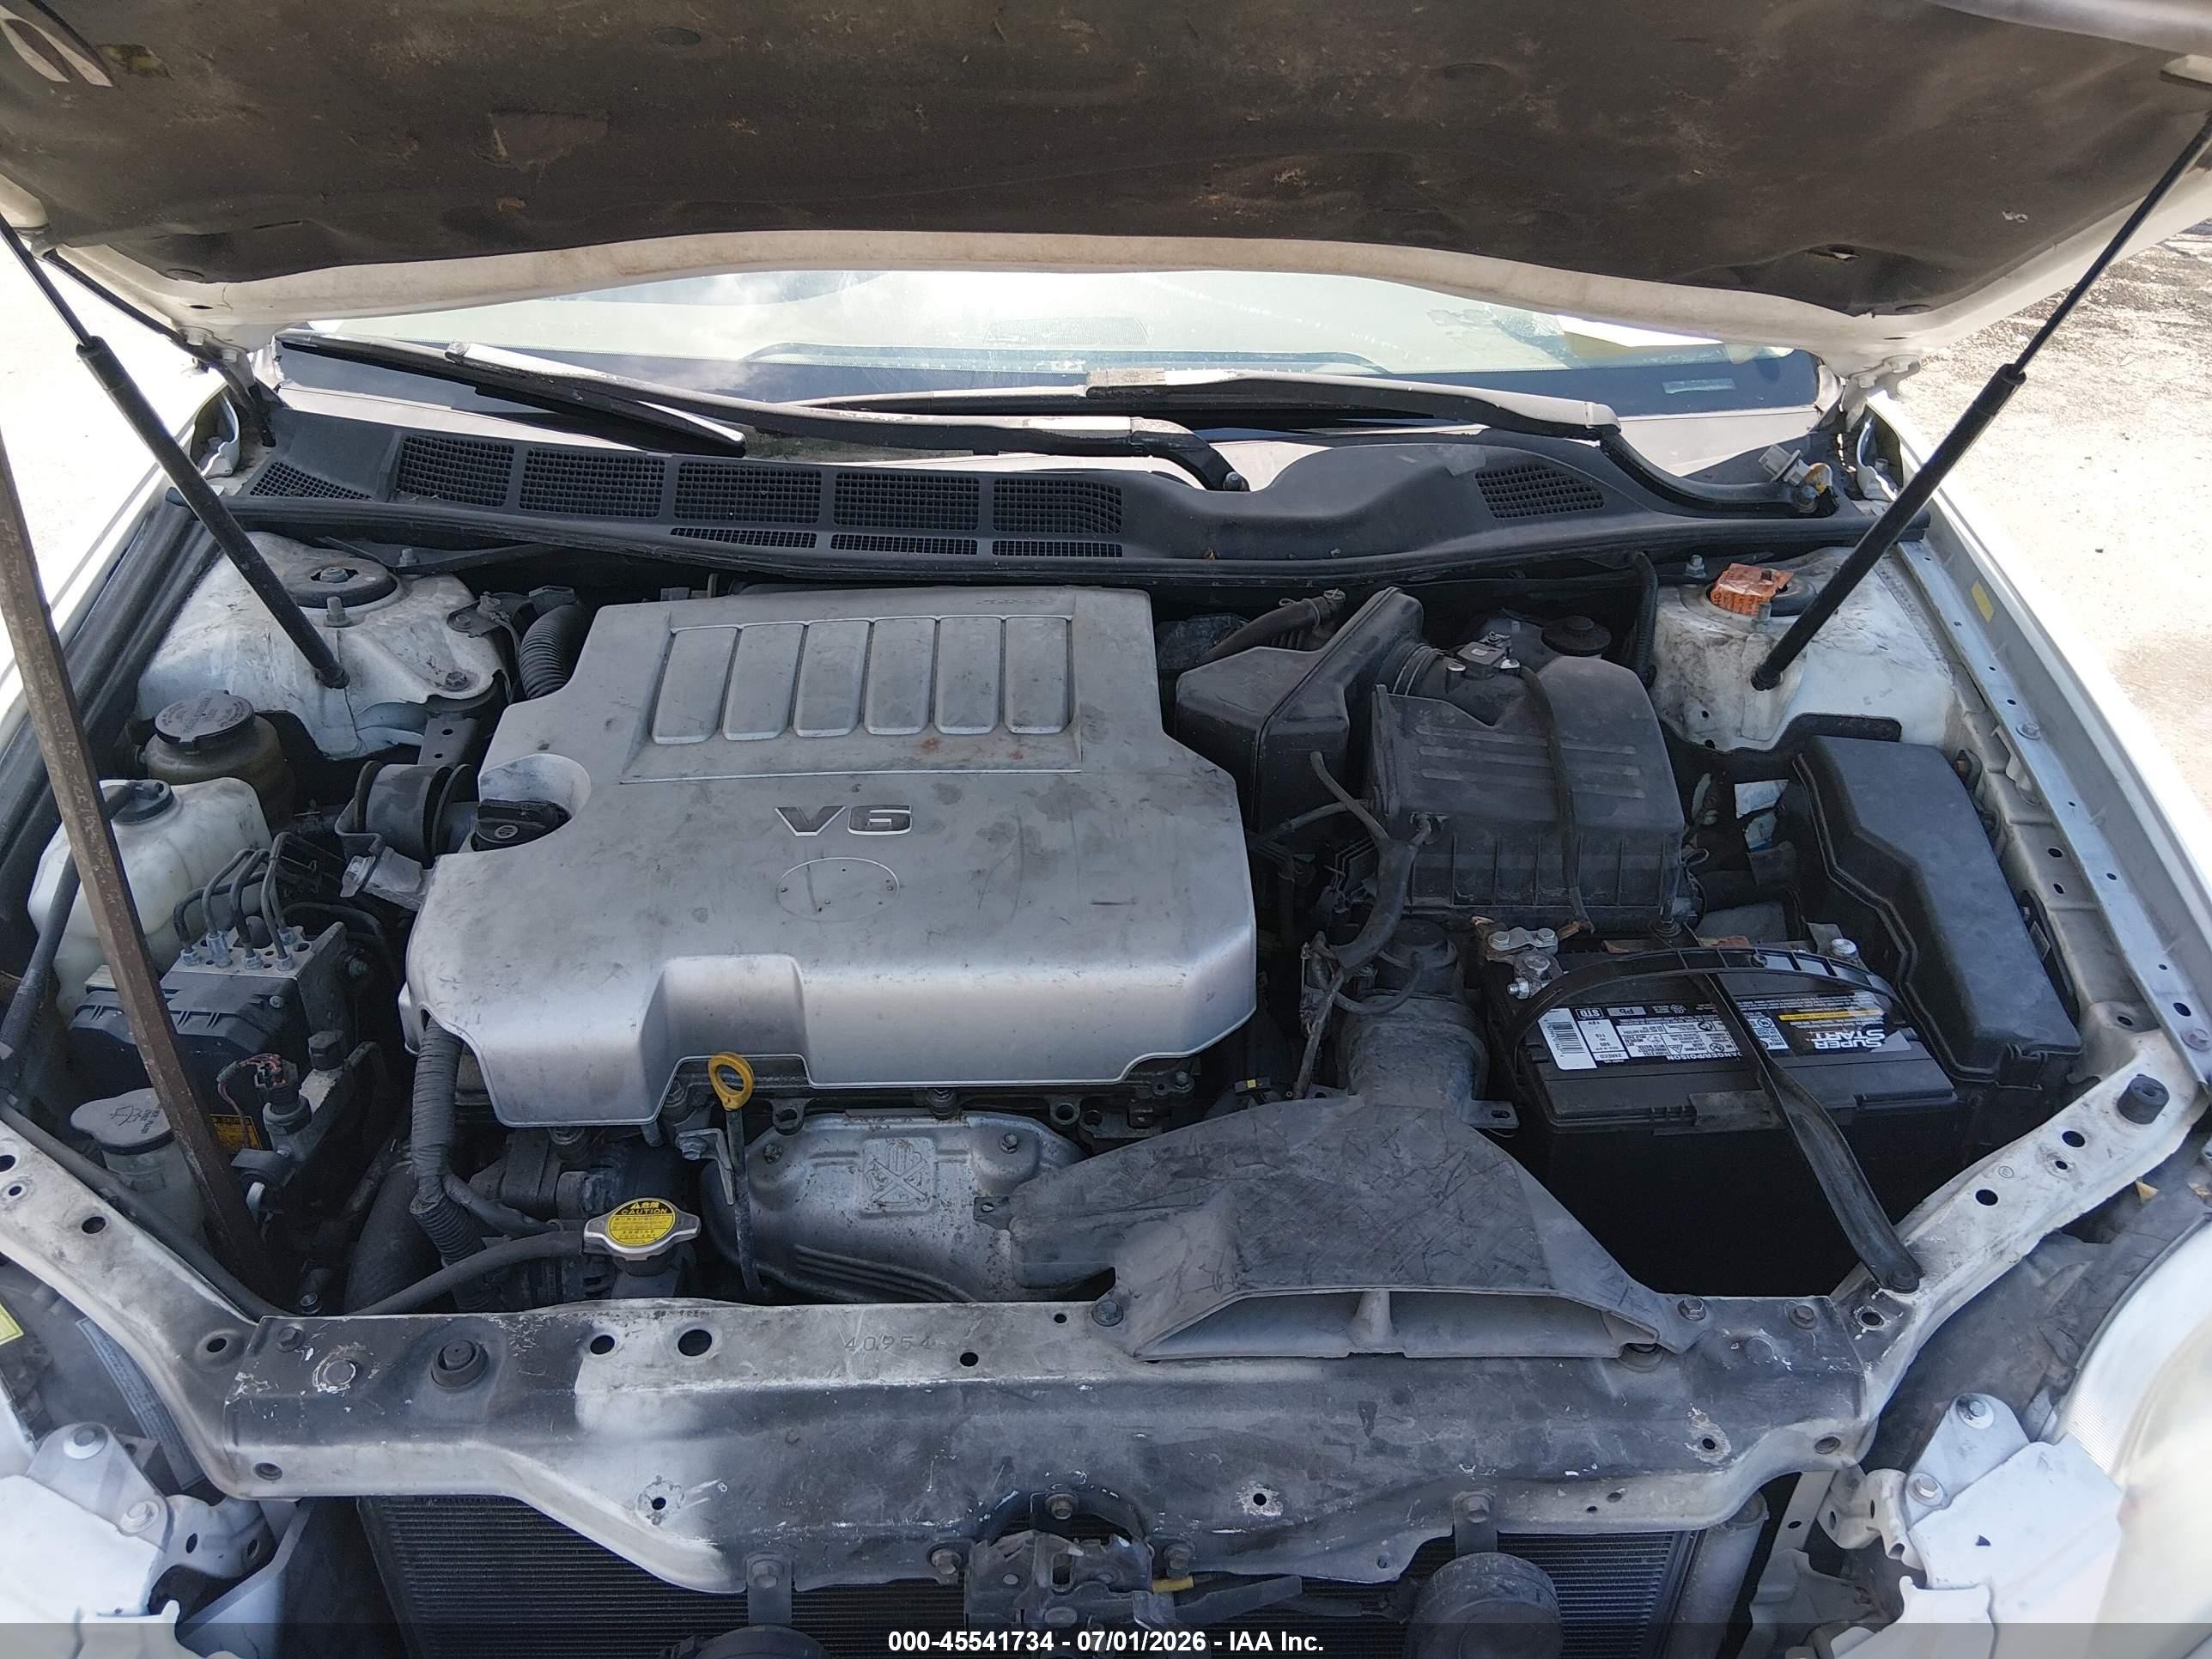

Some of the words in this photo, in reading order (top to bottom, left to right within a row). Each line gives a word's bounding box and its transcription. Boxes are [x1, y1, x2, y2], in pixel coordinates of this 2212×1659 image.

[775, 805, 912, 836] V6
[1811, 1029, 1885, 1042] START
[1814, 1038, 1882, 1048] SUPER
